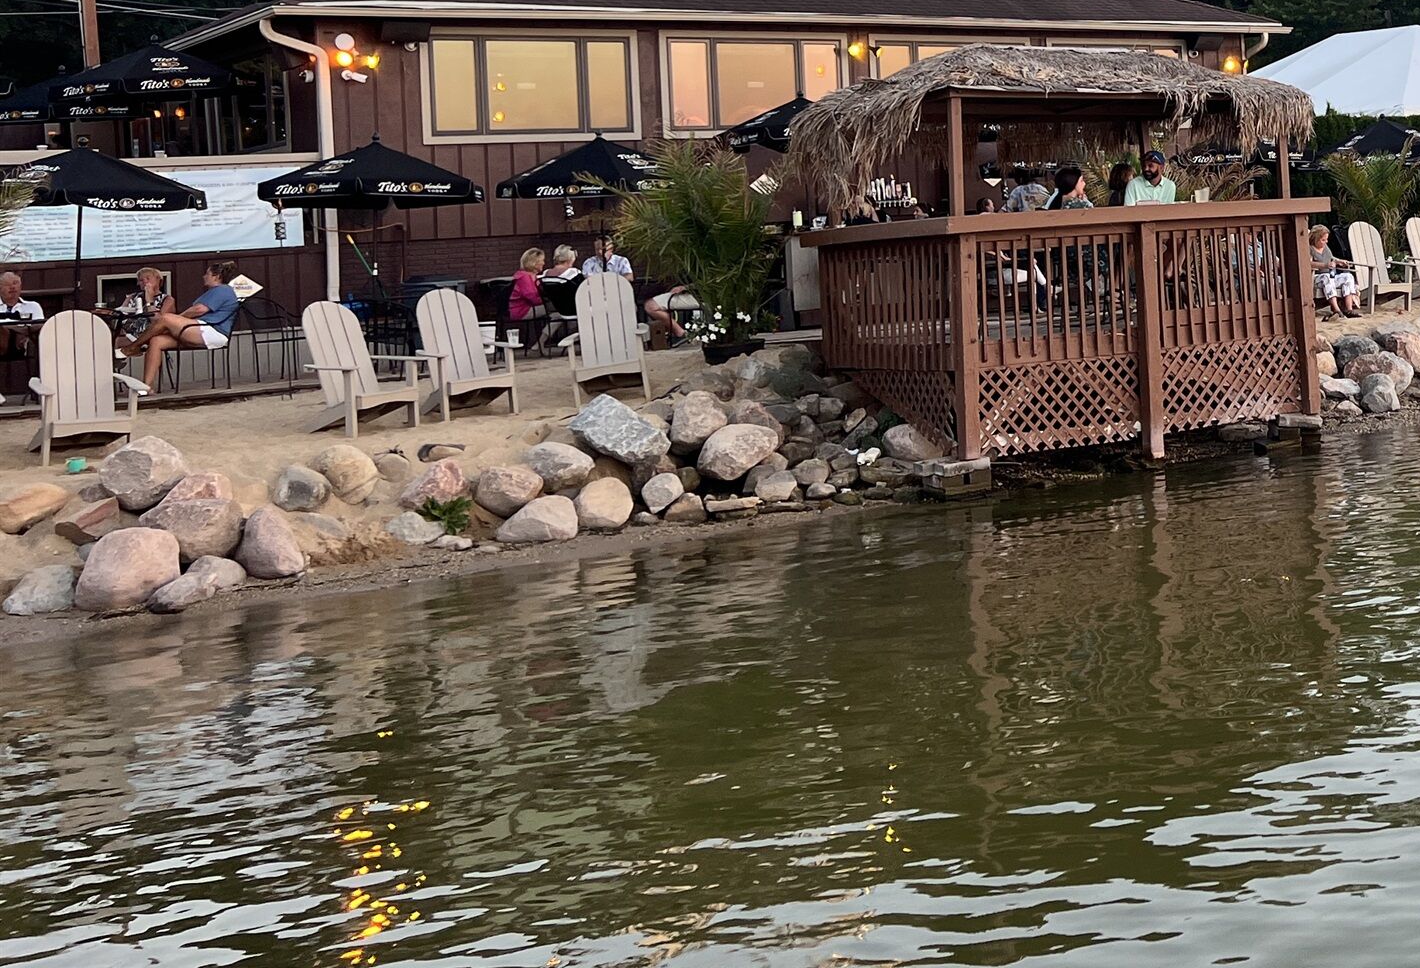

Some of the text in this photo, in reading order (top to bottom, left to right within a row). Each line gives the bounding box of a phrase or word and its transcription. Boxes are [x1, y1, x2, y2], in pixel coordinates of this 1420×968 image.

[140, 78, 170, 90] Tito's
[62, 85, 85, 97] Tito's
[69, 106, 94, 116] Tito's
[275, 183, 305, 195] Tito's
[377, 180, 408, 193] Tito's
[536, 185, 565, 197] Tito's
[86, 197, 119, 209] Tito's
